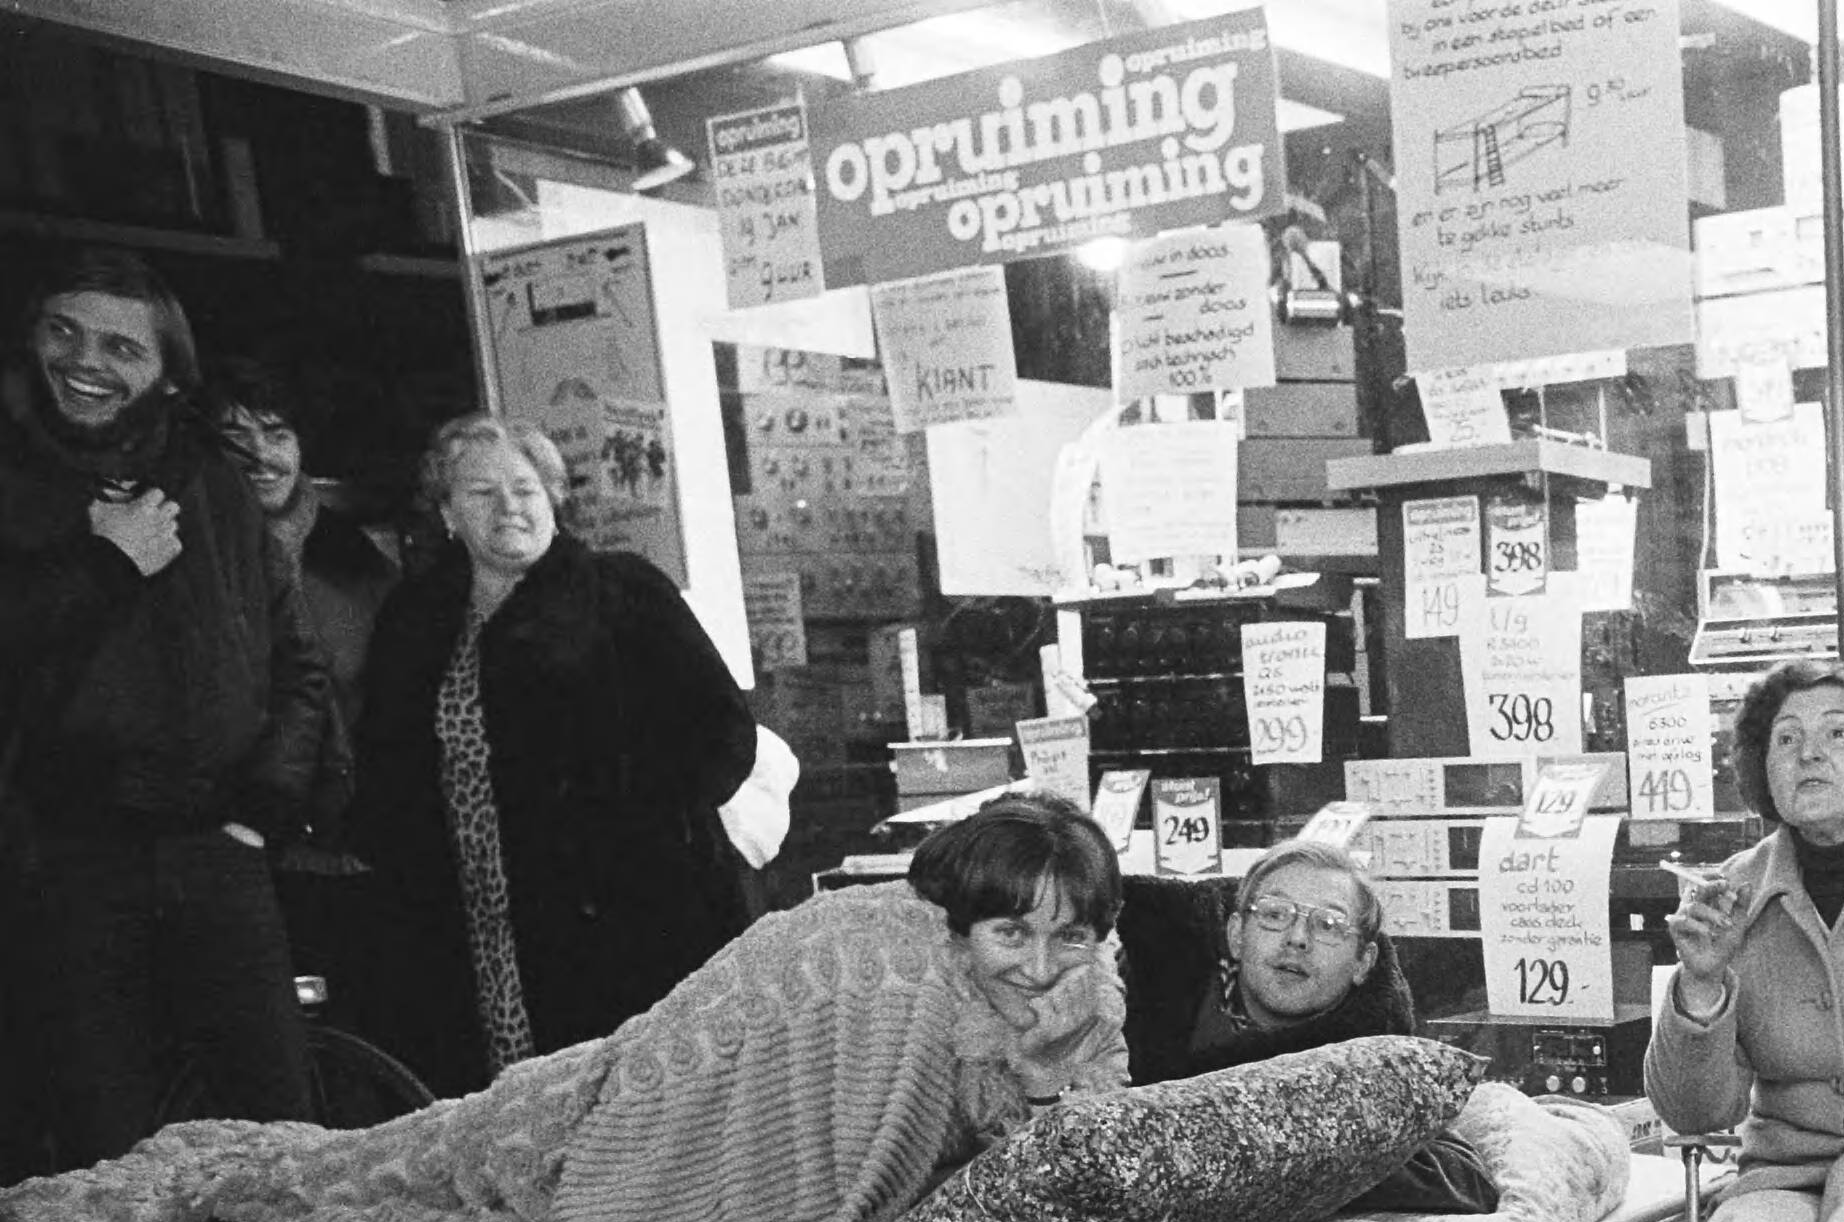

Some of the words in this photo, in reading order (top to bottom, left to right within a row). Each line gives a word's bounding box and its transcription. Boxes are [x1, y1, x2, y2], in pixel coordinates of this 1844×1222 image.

[1424, 17, 1452, 31] ons
[1125, 28, 1268, 74] opruiming
[825, 53, 1238, 216] opruiming
[947, 136, 1264, 252] opruiming
[1199, 297, 1247, 315] doos
[1494, 540, 1543, 574] 398
[1488, 693, 1555, 743] 398
[1163, 815, 1210, 847] 249
[1499, 846, 1560, 873] dart
